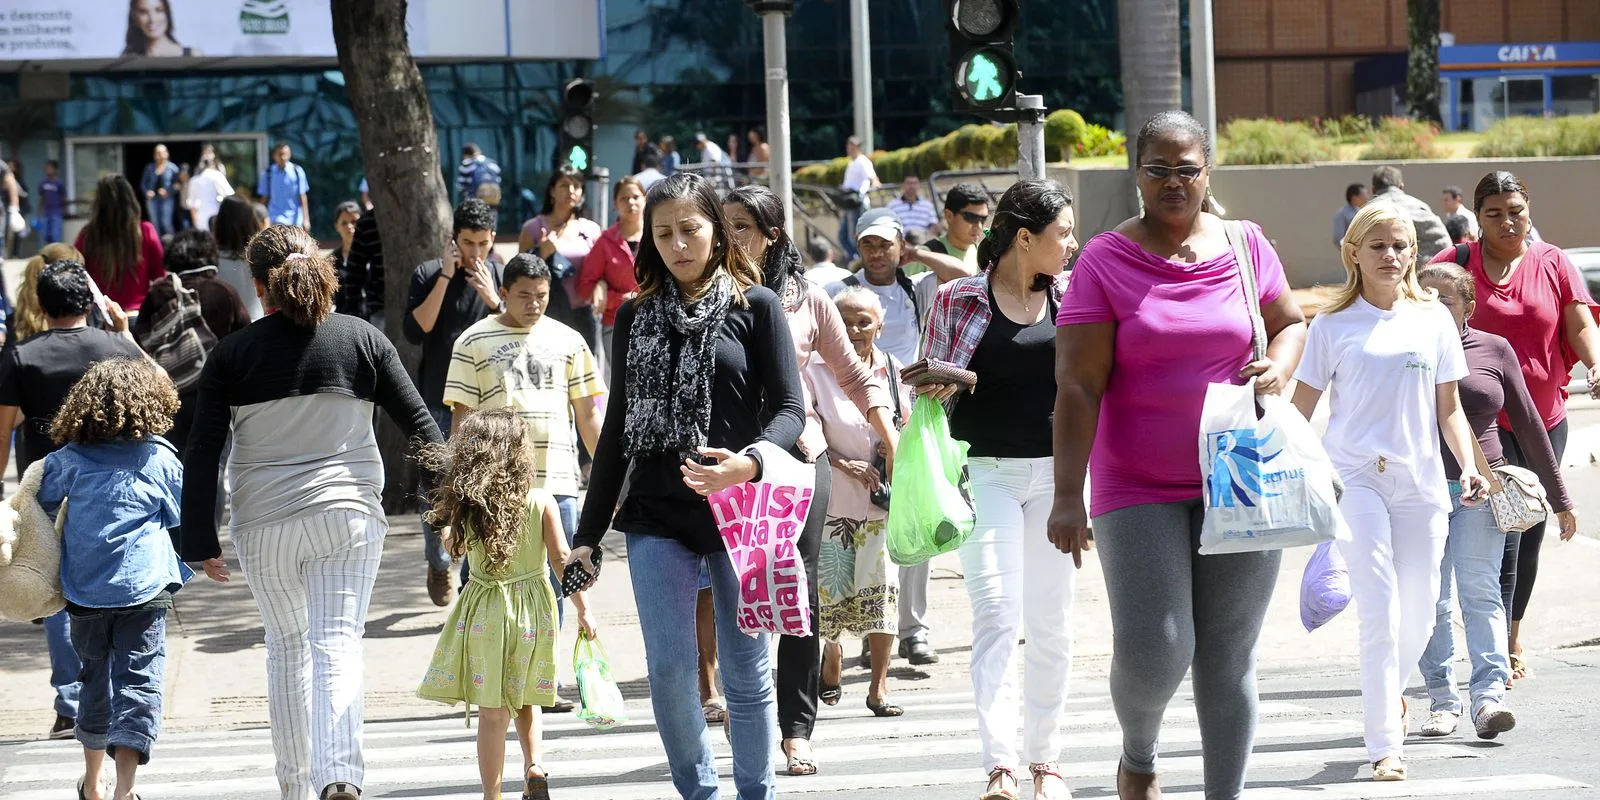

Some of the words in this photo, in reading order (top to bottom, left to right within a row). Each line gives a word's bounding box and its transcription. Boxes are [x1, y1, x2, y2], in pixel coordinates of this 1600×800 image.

[10, 9, 72, 21] desconto
[12, 23, 72, 36] milhares
[1497, 45, 1556, 62] CAIXA
[773, 521, 804, 635] marisa
